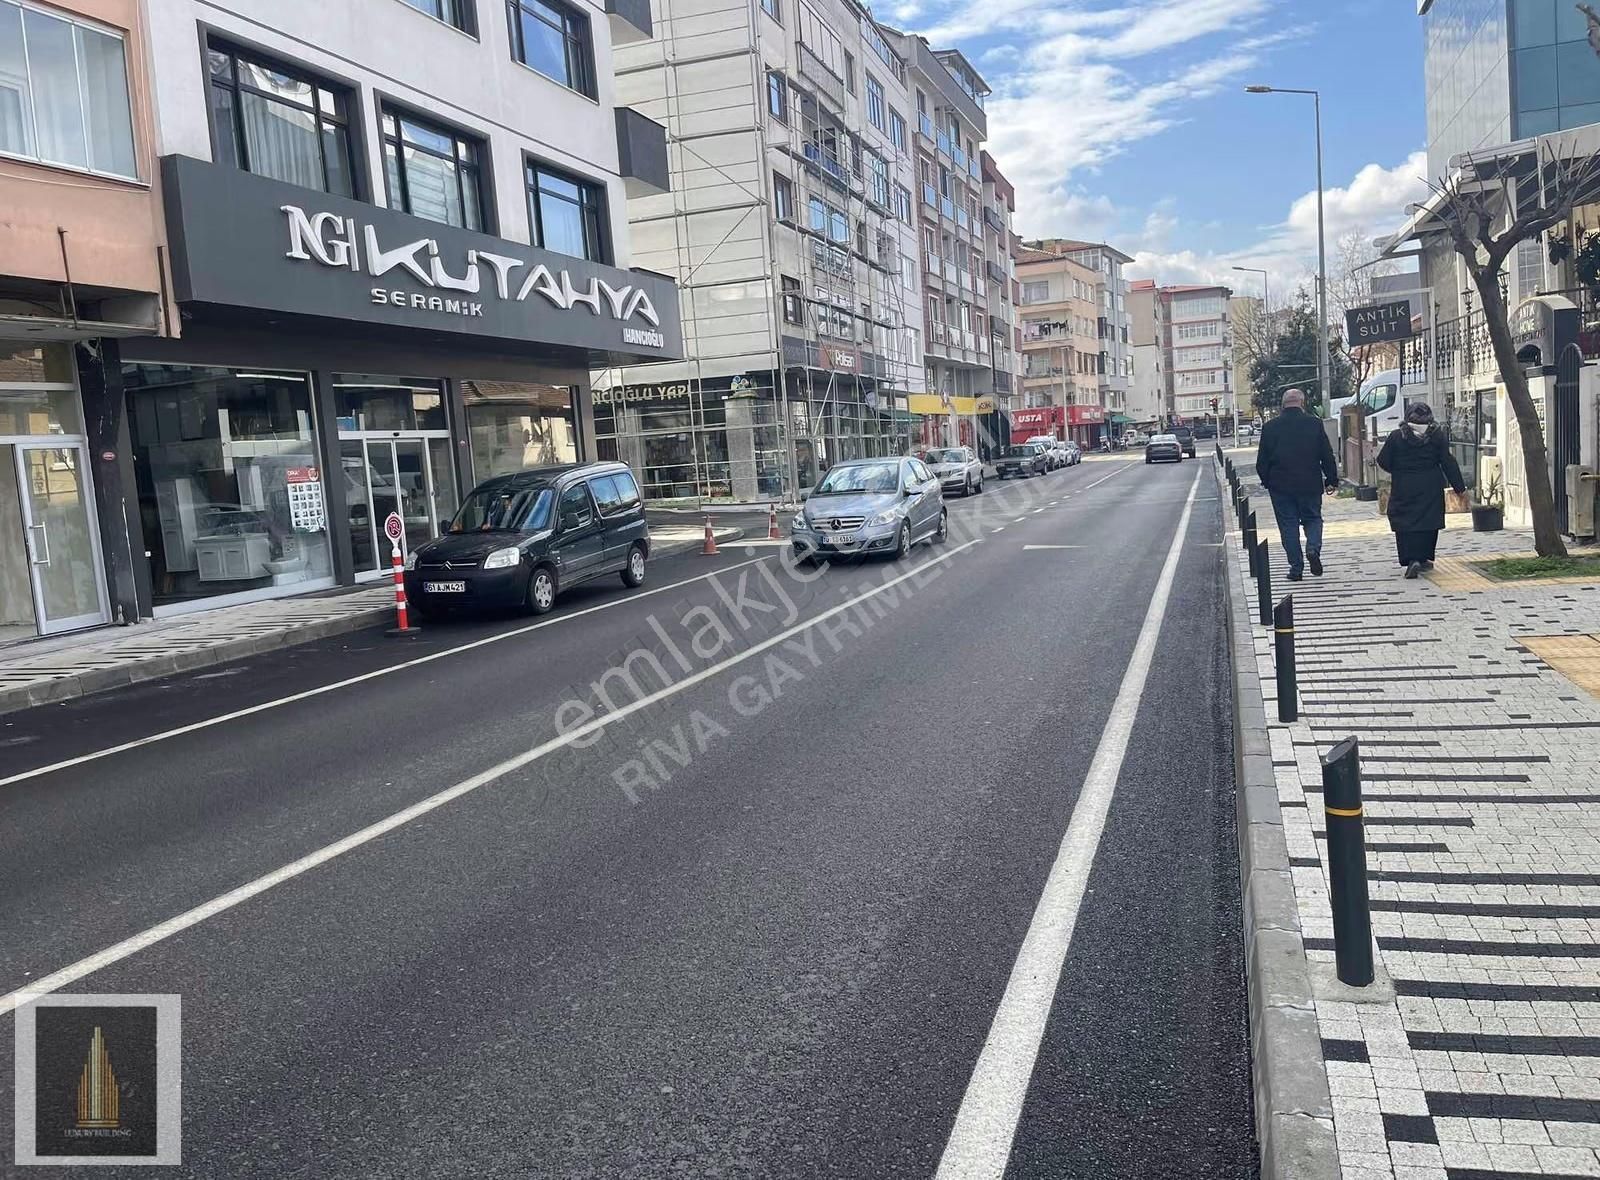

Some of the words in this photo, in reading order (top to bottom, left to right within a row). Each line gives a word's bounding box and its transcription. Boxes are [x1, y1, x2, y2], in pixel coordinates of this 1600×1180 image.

[281, 204, 350, 267] NG
[363, 224, 660, 327] KÜTAHYA
[1018, 412, 1043, 423] USTA
